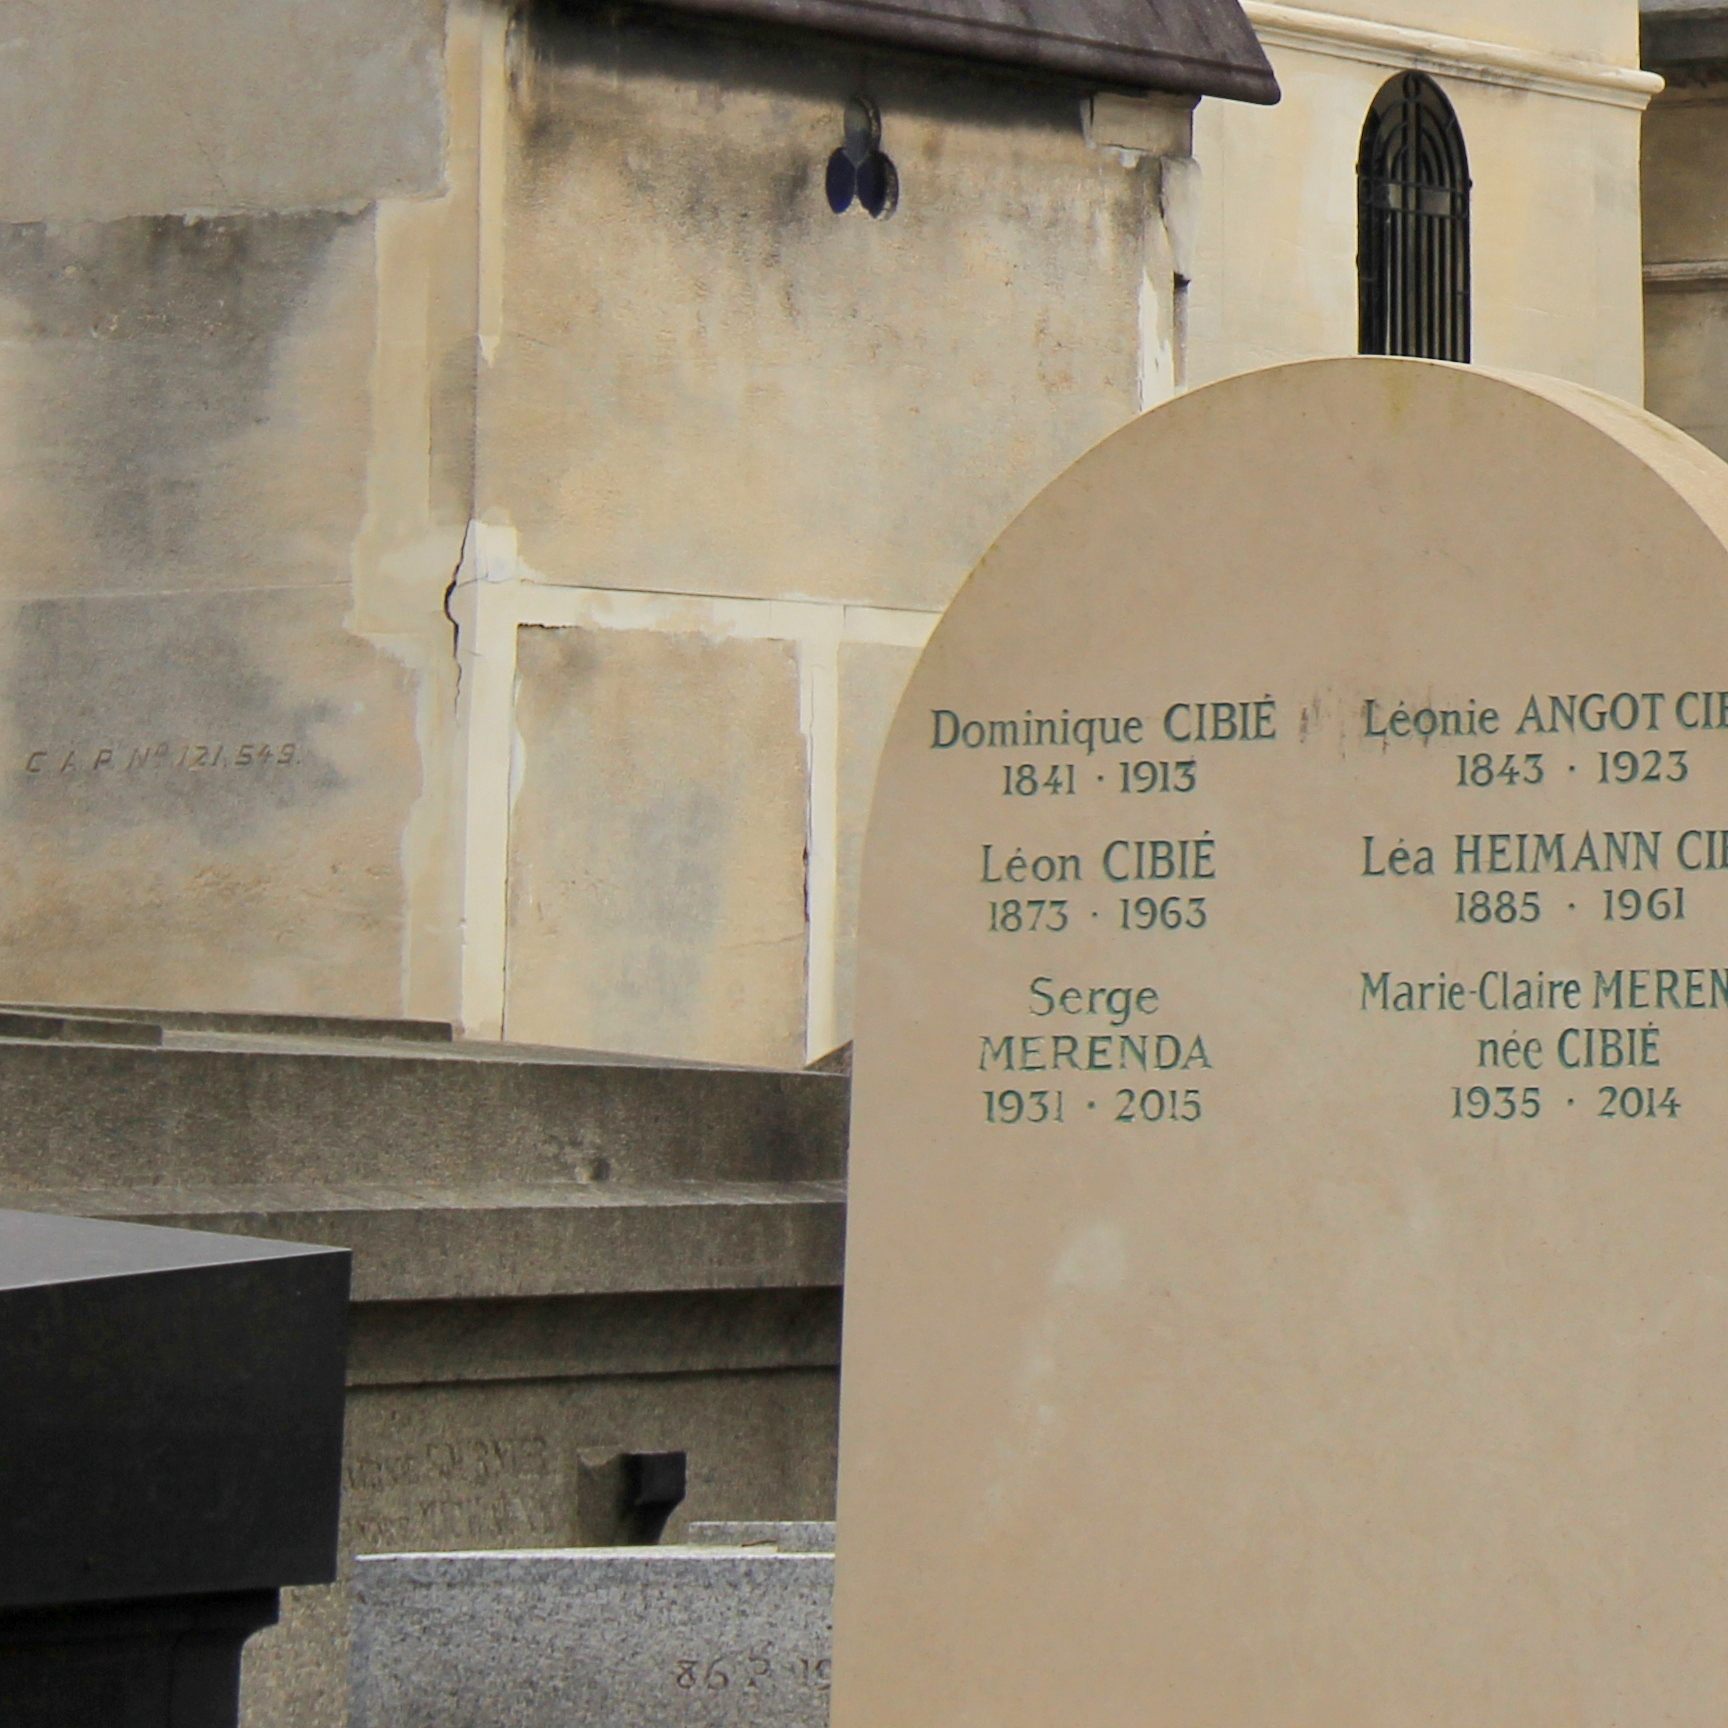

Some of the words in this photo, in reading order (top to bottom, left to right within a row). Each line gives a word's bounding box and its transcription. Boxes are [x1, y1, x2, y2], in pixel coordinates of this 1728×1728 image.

[930, 708, 1144, 757] Dominique
[1163, 693, 1277, 744] CIBIÉ
[1364, 698, 1499, 742] Léonie
[1515, 691, 1666, 735] ANGOT
[1003, 763, 1075, 797] 1841
[1119, 759, 1197, 794] 1913
[1457, 752, 1545, 788] 1843
[1599, 749, 1689, 785] 1923
[981, 844, 1082, 884] Léon
[1102, 829, 1216, 883] CIBIÉ
[1362, 835, 1435, 877] Léa
[1455, 830, 1662, 875] HEIMANN
[990, 899, 1068, 933] 1873
[1121, 896, 1207, 931] 1963
[1456, 890, 1541, 925] 1885
[1603, 887, 1685, 922] 1961
[1029, 976, 1159, 1028] Serge
[1361, 970, 1582, 1012] Marie-Claire
[979, 1034, 1212, 1072] MERENDA
[1478, 1038, 1543, 1071] née
[1557, 1020, 1661, 1070] CIBIÉ
[983, 1089, 1063, 1125] 1931
[1115, 1088, 1202, 1123] 2015
[1453, 1085, 1541, 1121] 1935
[1598, 1085, 1681, 1119] 2014
